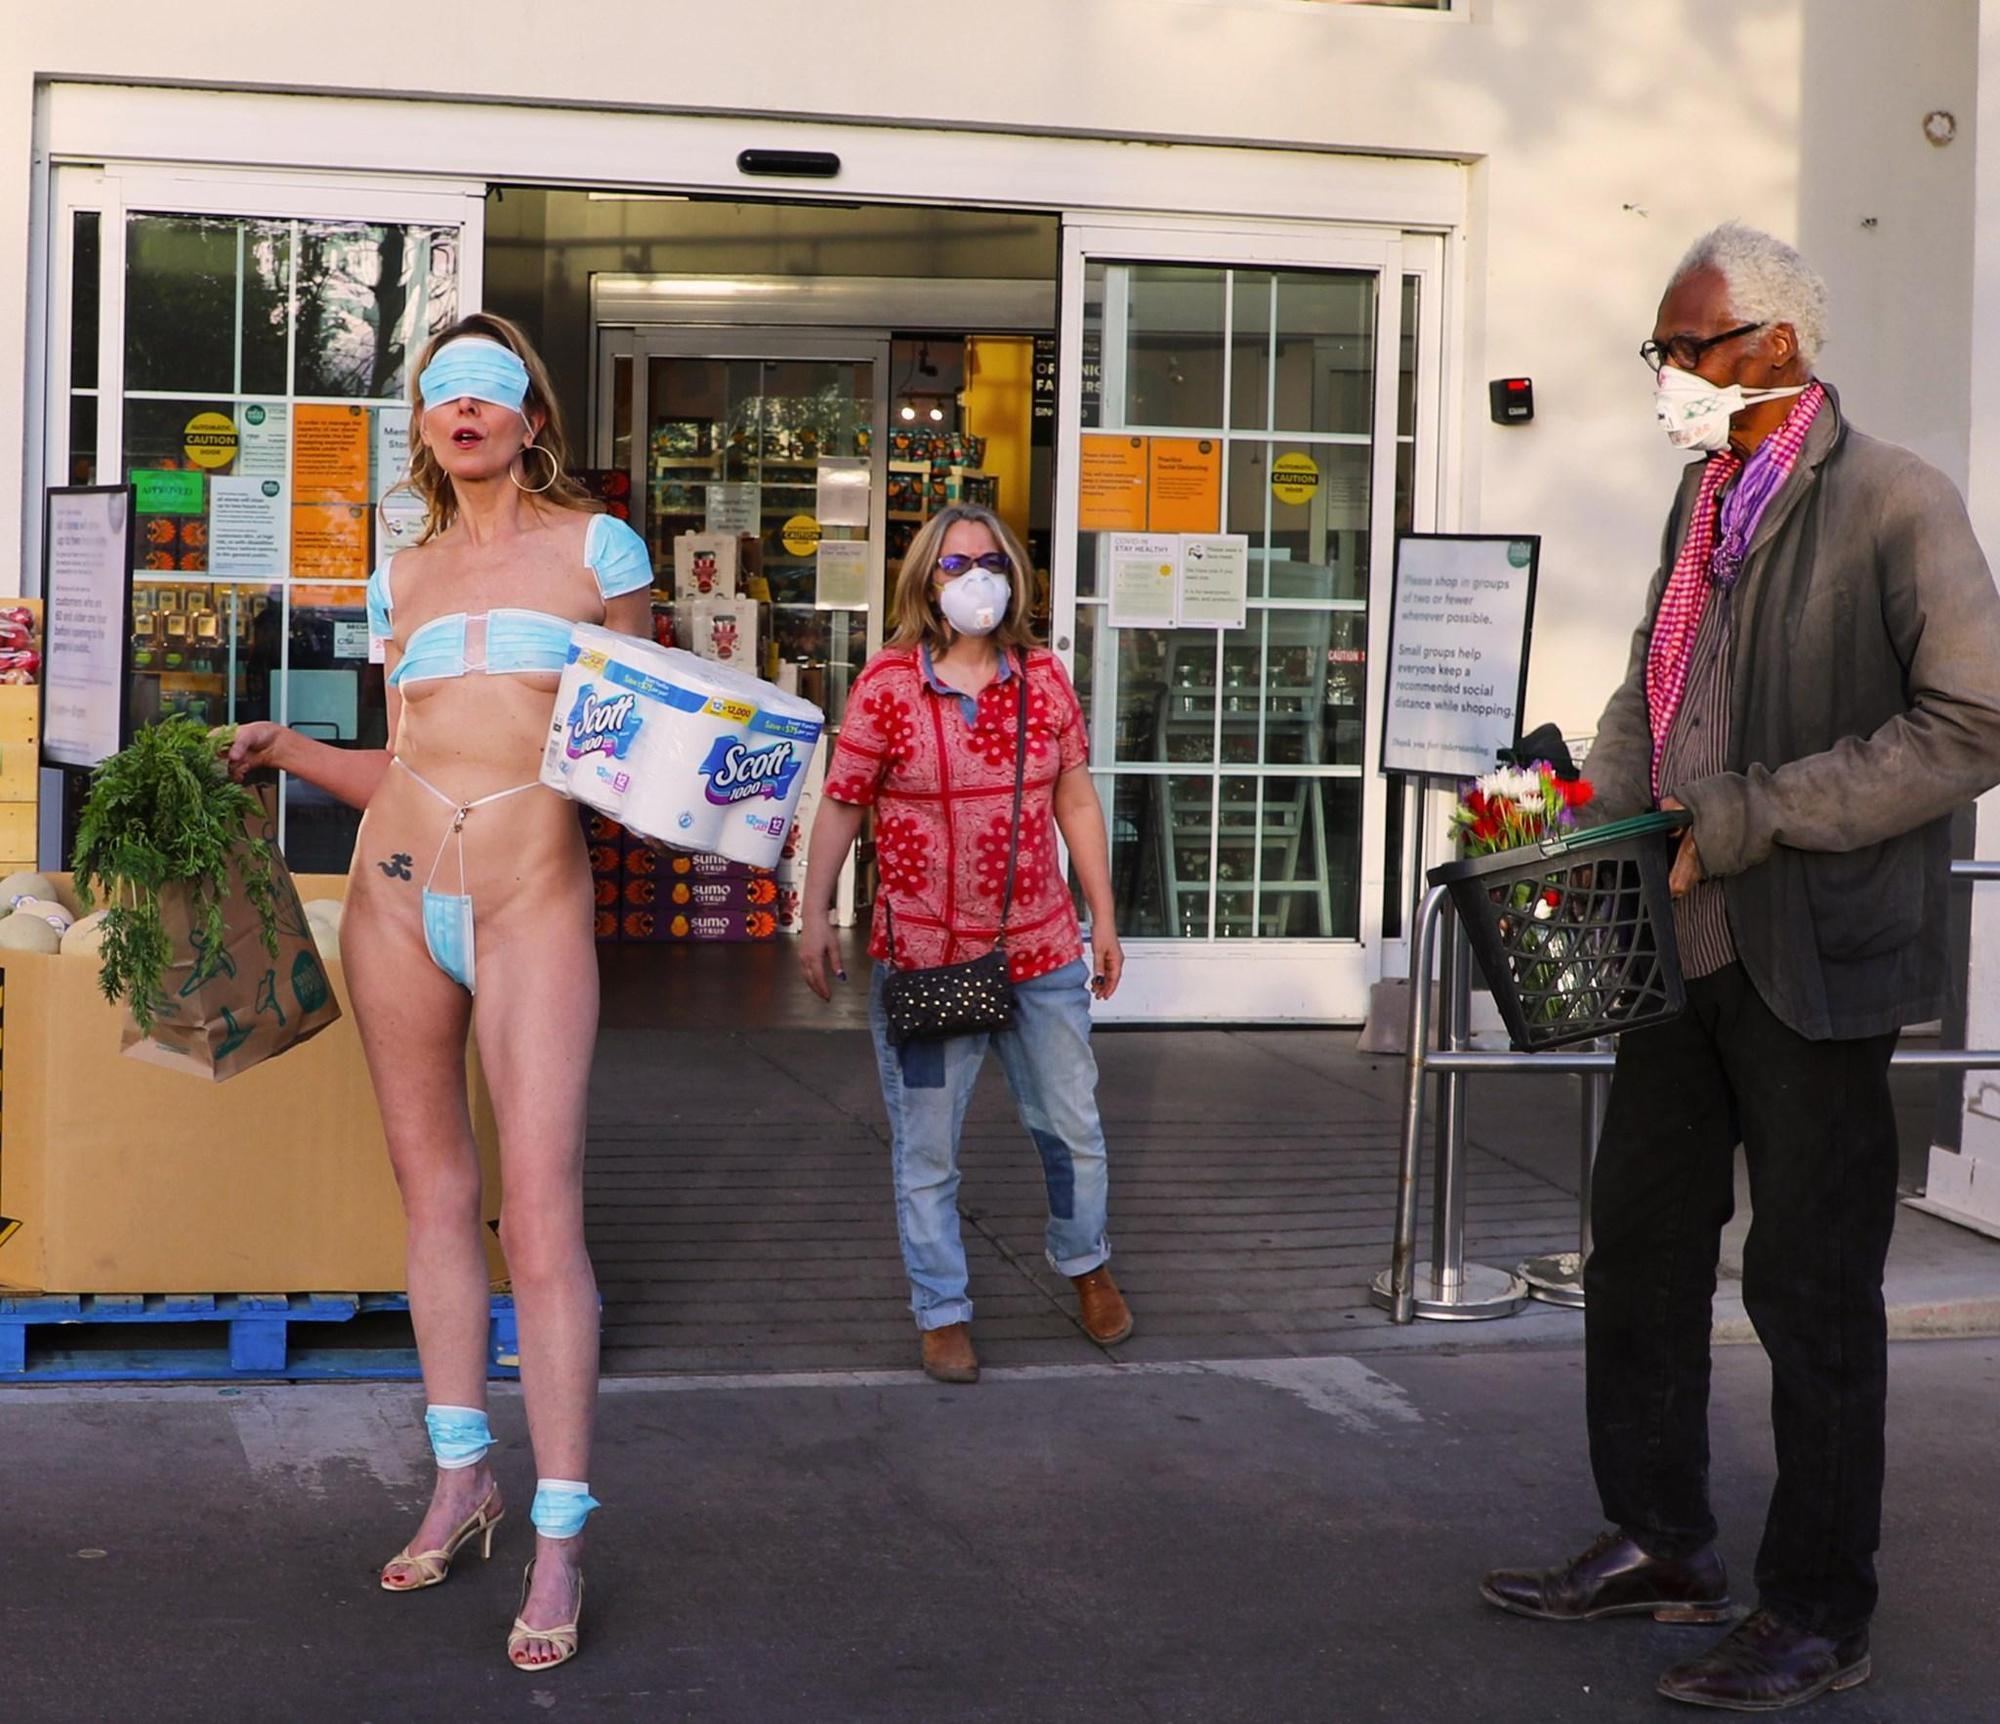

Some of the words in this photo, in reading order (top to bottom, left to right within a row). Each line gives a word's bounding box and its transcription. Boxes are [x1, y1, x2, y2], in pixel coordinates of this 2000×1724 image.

[186, 435, 236, 444] CAUTION
[1274, 474, 1316, 484] CAUTION
[784, 532, 820, 540] CAUTION
[1403, 574, 1432, 586] Please
[1434, 577, 1458, 590] shop
[1460, 578, 1470, 588] in
[1472, 579, 1510, 592] groups
[1402, 591, 1412, 603] of
[1414, 594, 1430, 604] two
[1432, 595, 1443, 604] or
[1444, 593, 1474, 605] fewer
[1402, 611, 1444, 622] whenever
[1446, 612, 1493, 624] possible.
[1398, 644, 1422, 656] Small
[1423, 648, 1456, 660] groups
[1458, 647, 1482, 662] help
[1398, 664, 1436, 676] everyone
[1438, 664, 1462, 678] keep
[1465, 668, 1471, 677] a
[1396, 680, 1460, 694] recommended
[1462, 684, 1494, 696] social
[728, 704, 752, 718] 12,000
[1395, 697, 1431, 710] distance
[1434, 699, 1459, 712] while
[1460, 700, 1514, 719] shopping.
[574, 693, 634, 738] Scott
[714, 742, 792, 786] Scott
[729, 781, 762, 801] 1000
[772, 820, 782, 830] 12
